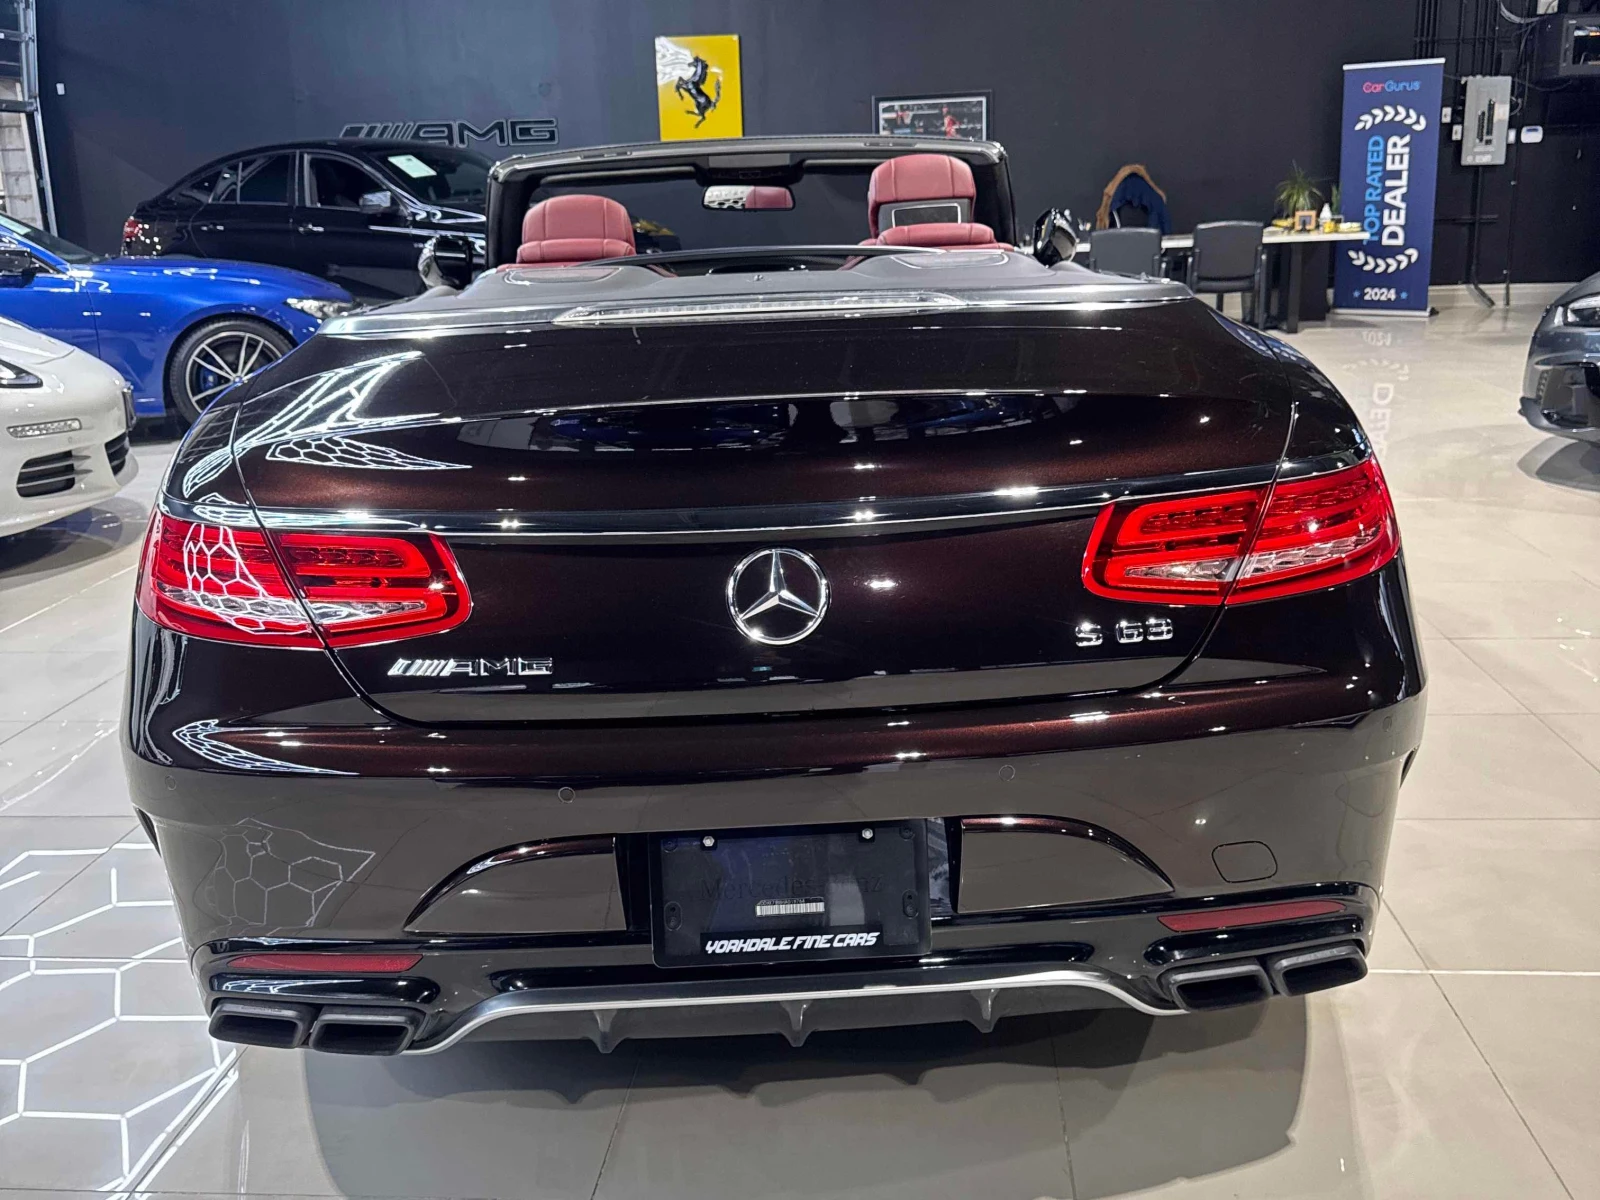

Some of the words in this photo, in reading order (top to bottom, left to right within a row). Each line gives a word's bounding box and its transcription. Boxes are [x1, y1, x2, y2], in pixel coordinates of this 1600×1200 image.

[1362, 80, 1421, 93] CarGurus
[408, 119, 558, 147] AMG
[1366, 135, 1384, 200] RATED
[1381, 134, 1411, 246] DEALER
[1363, 204, 1381, 245] TOP
[1363, 288, 1397, 301] 2024
[1075, 622, 1103, 647] S
[1116, 618, 1173, 643] 63
[439, 657, 553, 677] AMG
[705, 936, 794, 954] YORKDALE
[793, 935, 834, 949] FINE
[832, 932, 880, 947] CARS
